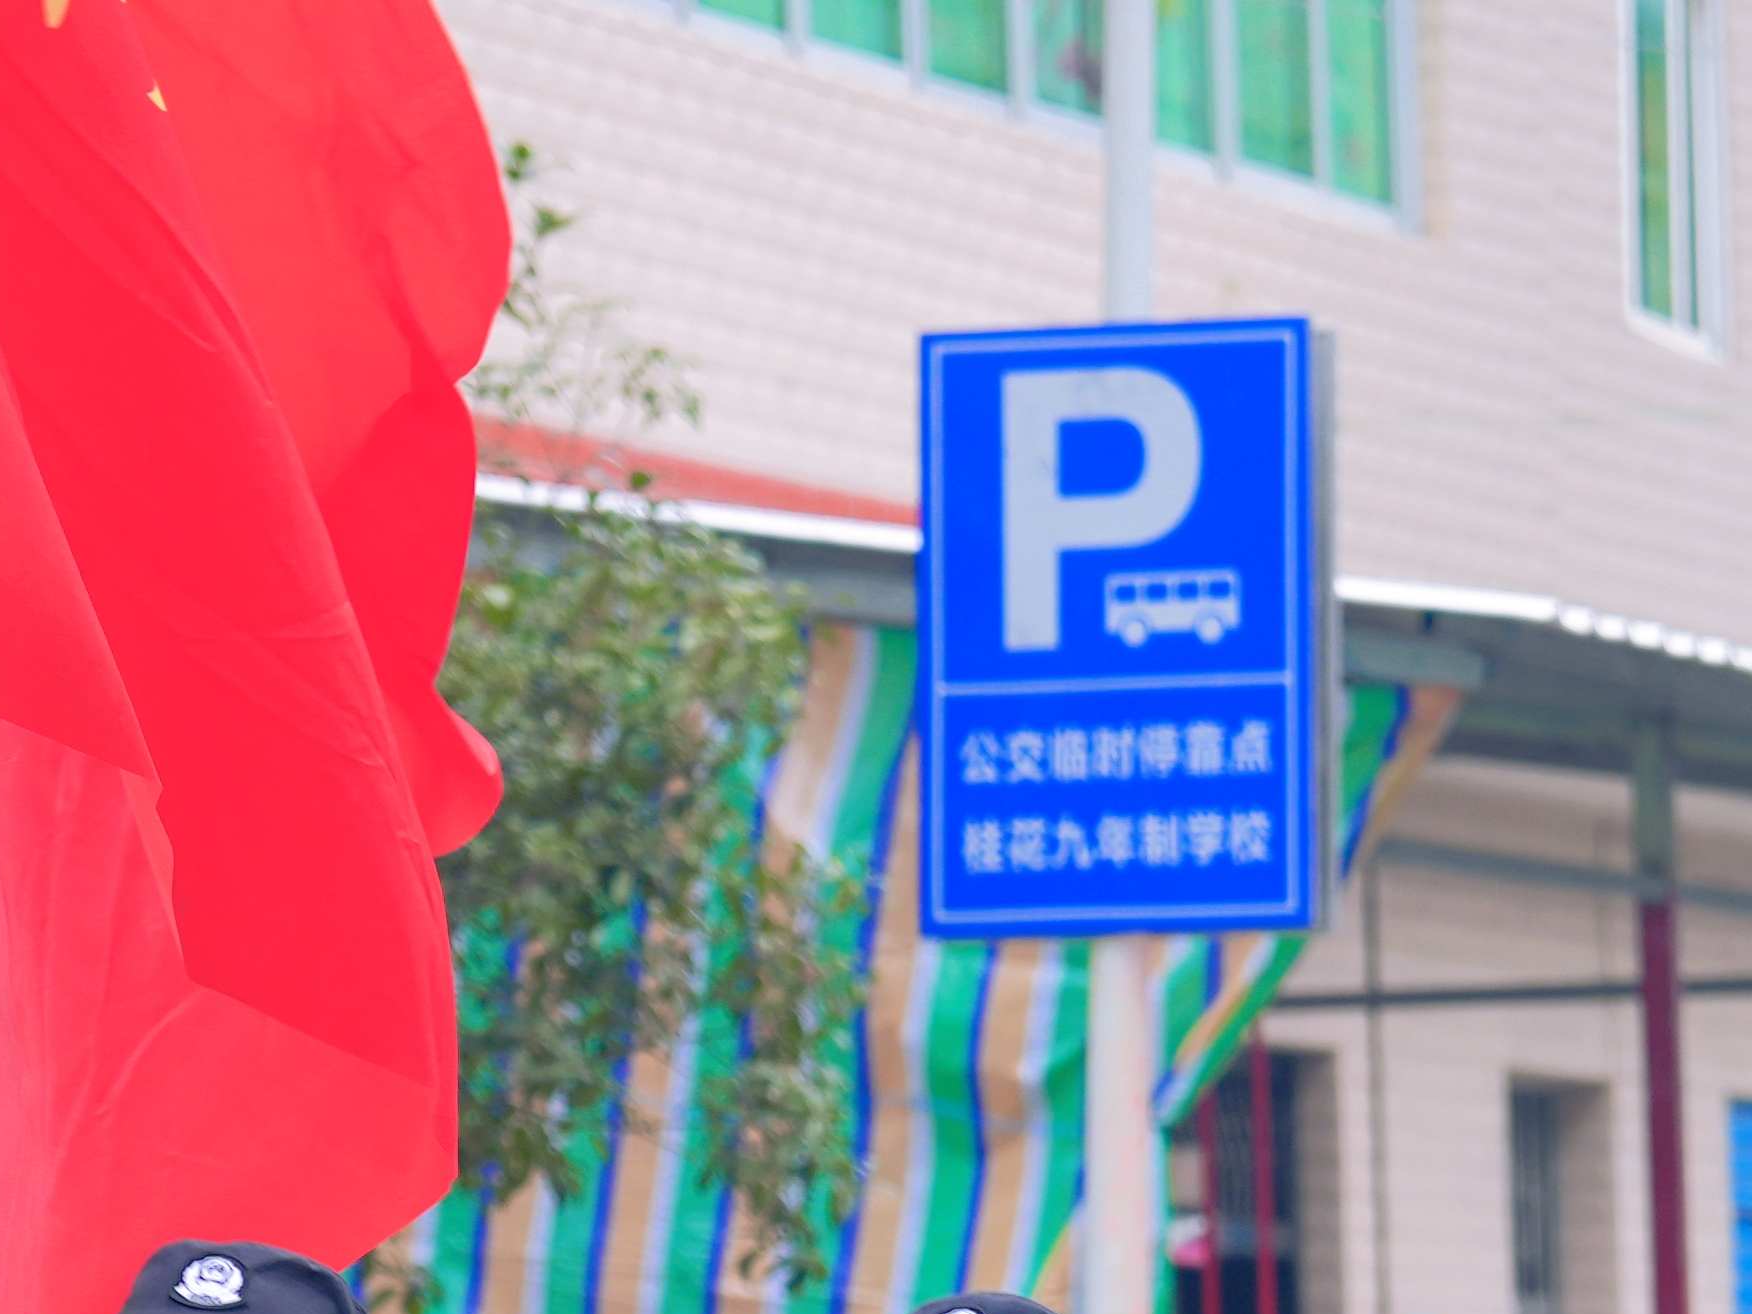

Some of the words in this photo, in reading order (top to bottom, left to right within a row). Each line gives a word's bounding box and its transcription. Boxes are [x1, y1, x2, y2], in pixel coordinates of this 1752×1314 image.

[1002, 367, 1202, 652] P
[961, 719, 1272, 784] 公交临时停靠点
[962, 811, 1272, 874] 桂花九年制学校
